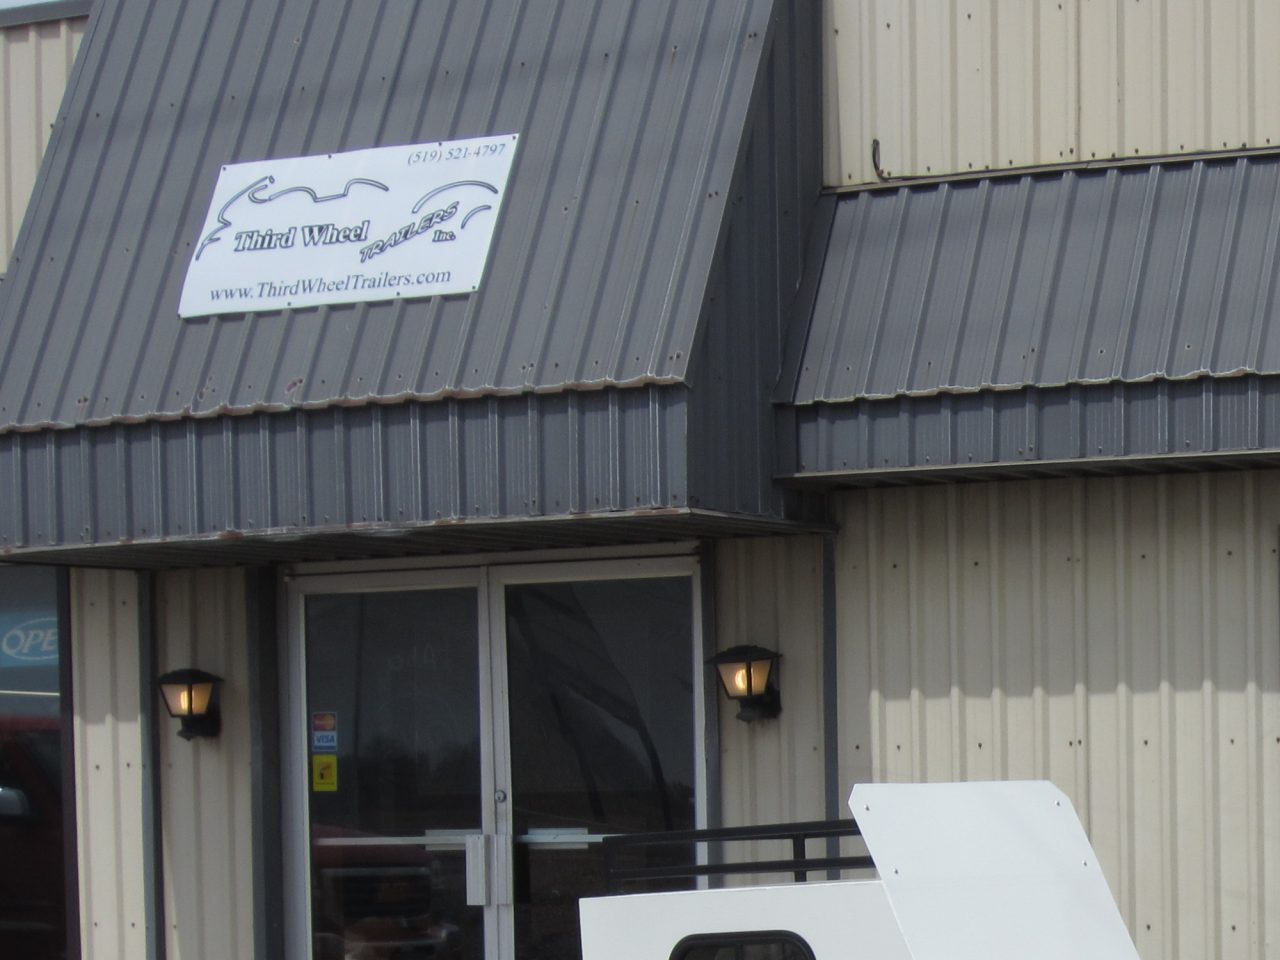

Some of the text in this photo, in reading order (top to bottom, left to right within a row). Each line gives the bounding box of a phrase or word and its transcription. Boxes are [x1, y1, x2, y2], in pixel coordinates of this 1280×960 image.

[407, 143, 506, 166] (519) 521-4797
[234, 220, 371, 252] Third Wheel
[359, 201, 460, 263] TRAILERS
[432, 229, 456, 242] Inc.
[210, 270, 452, 301] www.ThirdWheelTrailers.com
